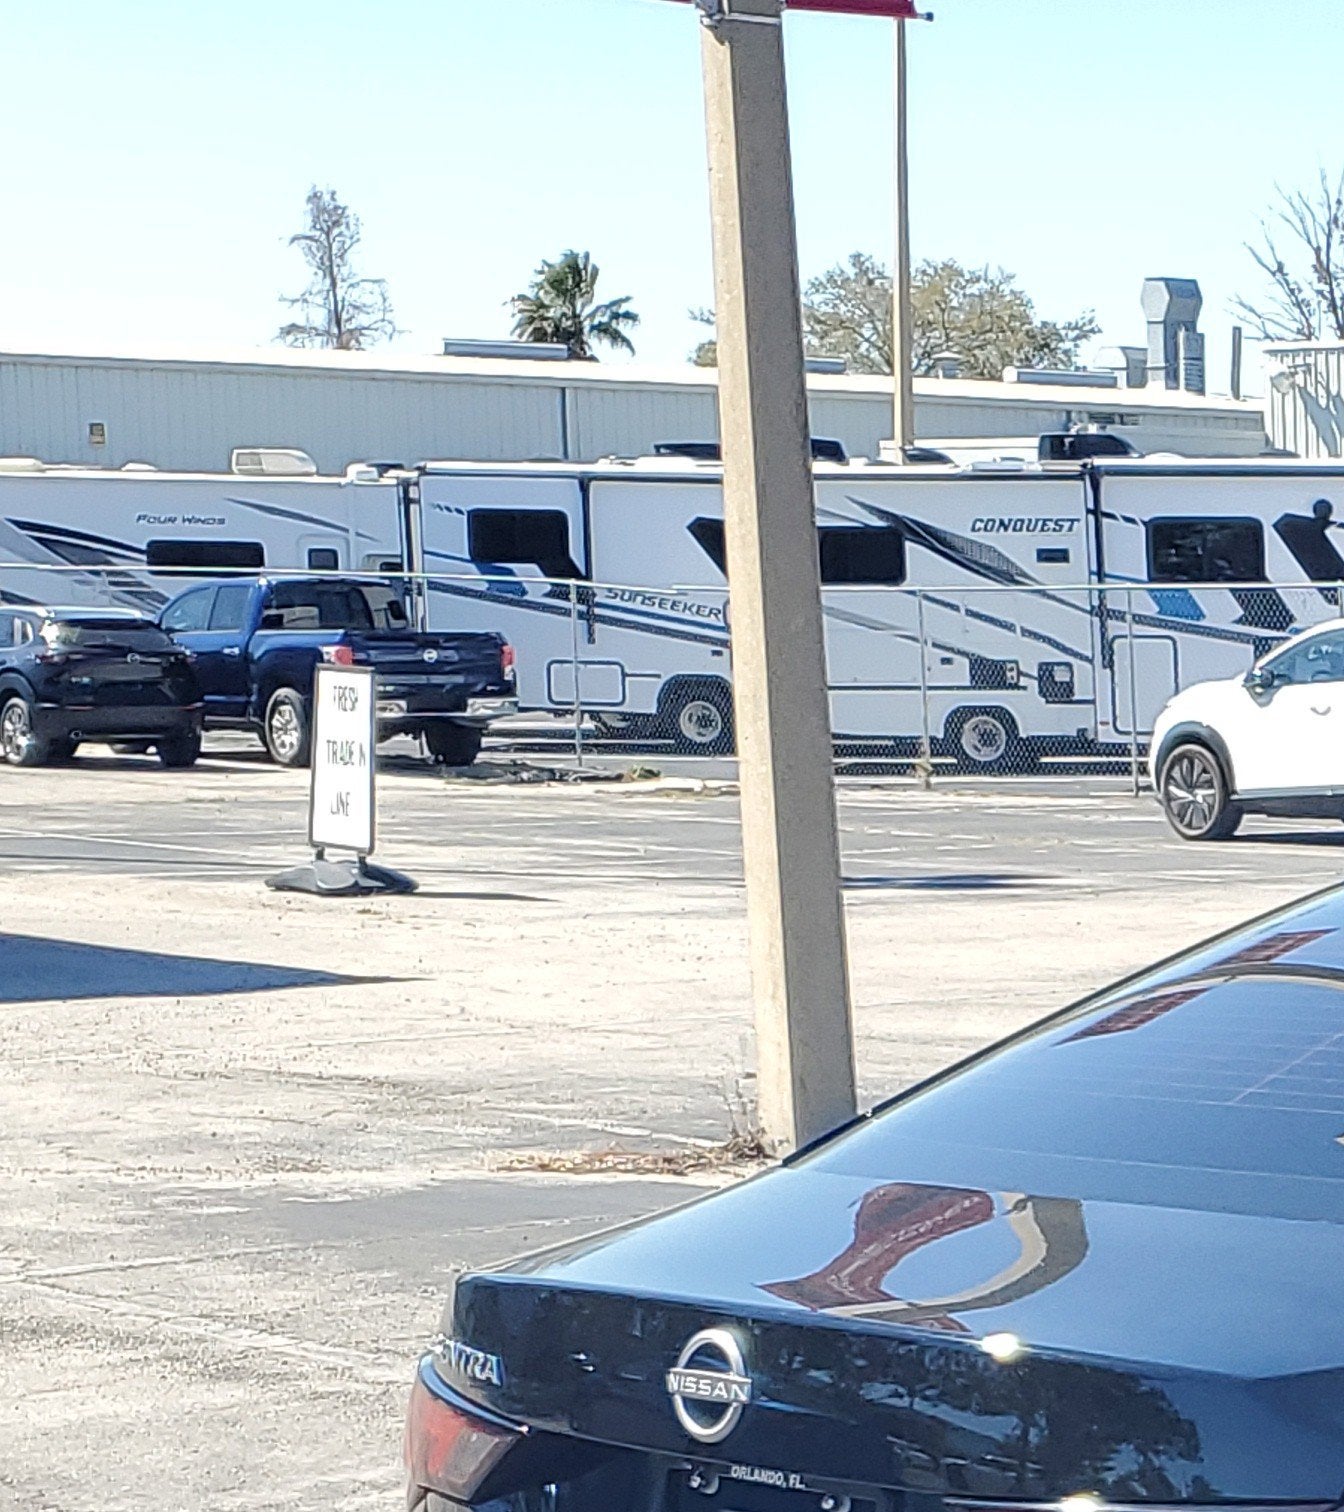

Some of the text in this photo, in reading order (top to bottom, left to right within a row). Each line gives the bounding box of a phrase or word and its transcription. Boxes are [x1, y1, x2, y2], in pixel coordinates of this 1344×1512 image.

[970, 517, 1081, 533] CONQUEST
[604, 589, 722, 621] SUNSEEKER
[667, 1372, 750, 1404] NISSAN
